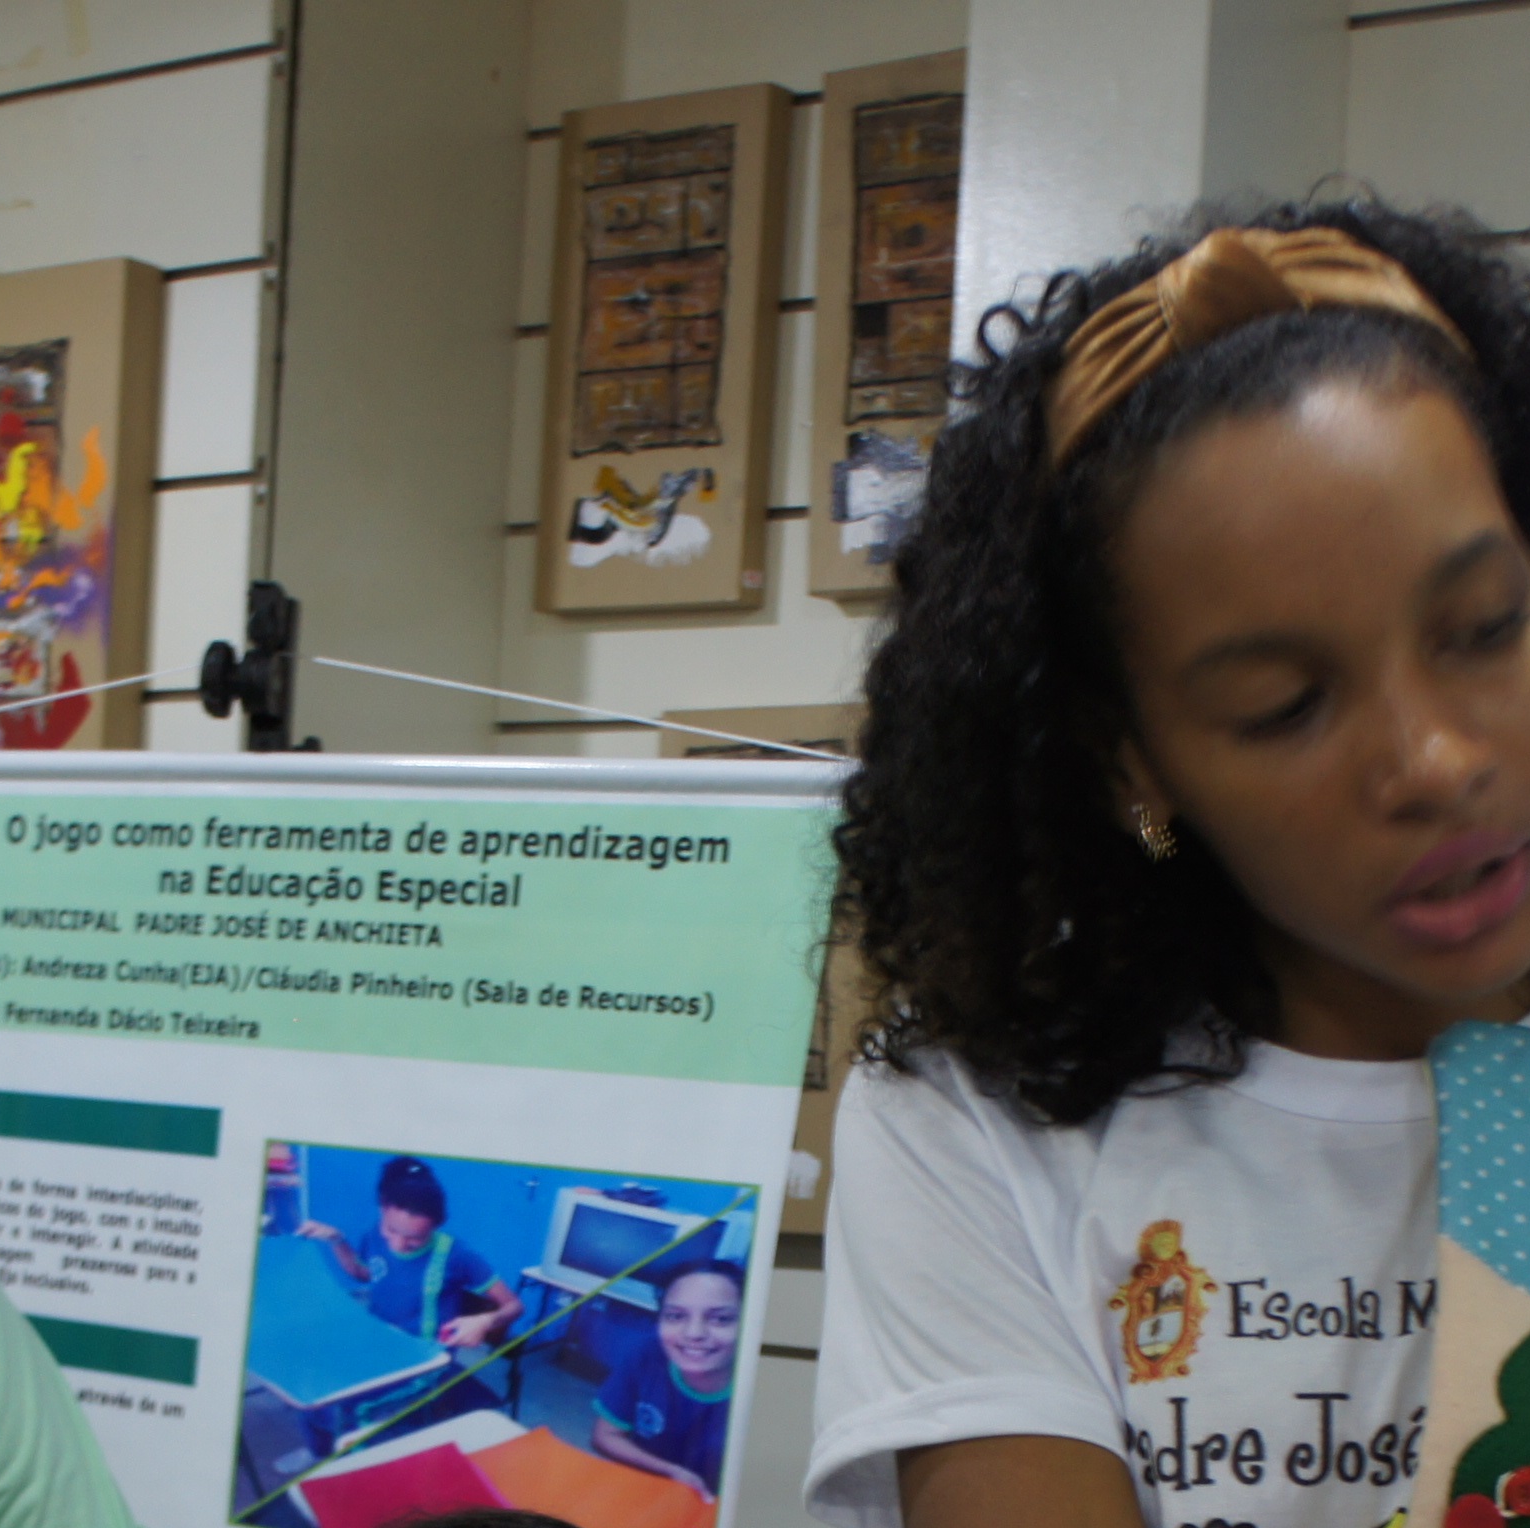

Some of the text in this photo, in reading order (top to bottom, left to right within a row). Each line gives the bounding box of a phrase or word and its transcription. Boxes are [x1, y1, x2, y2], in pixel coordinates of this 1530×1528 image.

[7, 814, 730, 871] O jogo como ferramenta de aprendizagem
[159, 863, 523, 911] na Educação Especial
[2, 907, 121, 935] MUNICIPAL
[134, 910, 204, 938] PADRE
[212, 907, 270, 941] JOSÉ
[277, 918, 307, 941] DE
[313, 919, 444, 949] ANCHIETA
[22, 955, 107, 984] Andreza
[349, 969, 455, 1001] Pinheiro
[462, 977, 530, 1009] (Sala
[538, 981, 570, 1009] de
[577, 984, 716, 1024] Recursos)
[2, 1001, 102, 1031] Fernanda
[171, 1009, 262, 1041] Teixeira
[1227, 1275, 1384, 1341] Escola
[1125, 1396, 1266, 1491] adre
